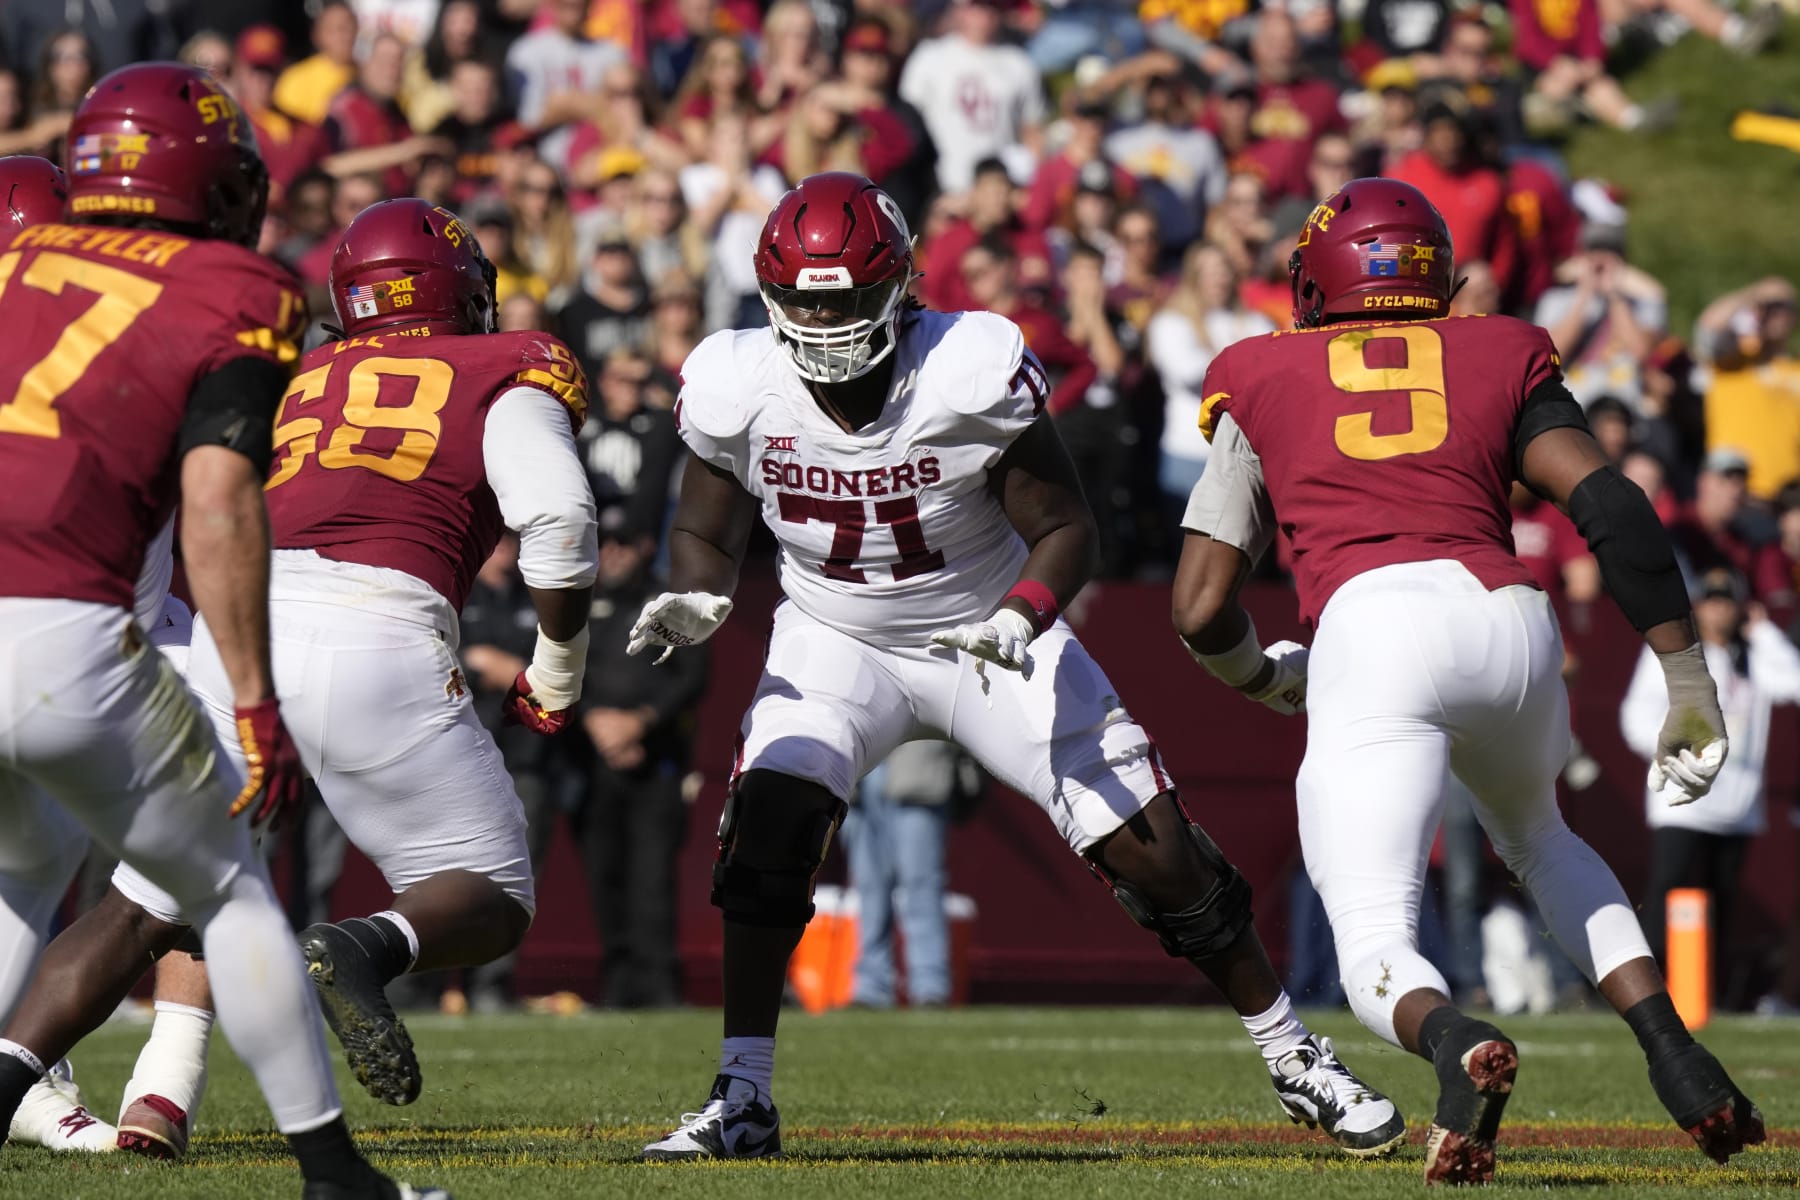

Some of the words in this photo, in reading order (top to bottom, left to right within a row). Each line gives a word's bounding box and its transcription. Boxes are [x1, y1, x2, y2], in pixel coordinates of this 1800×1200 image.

[10, 223, 190, 267] FREYLER
[386, 276, 415, 296] XII
[1420, 262, 1429, 275] 9
[393, 293, 413, 308] 58
[1363, 295, 1440, 310] CYCLONES
[0, 250, 164, 439] 7
[1328, 325, 1449, 461] 9
[263, 356, 455, 491] 58
[764, 435, 799, 452] XII
[761, 456, 942, 497] SOONERS
[776, 492, 946, 584] 71
